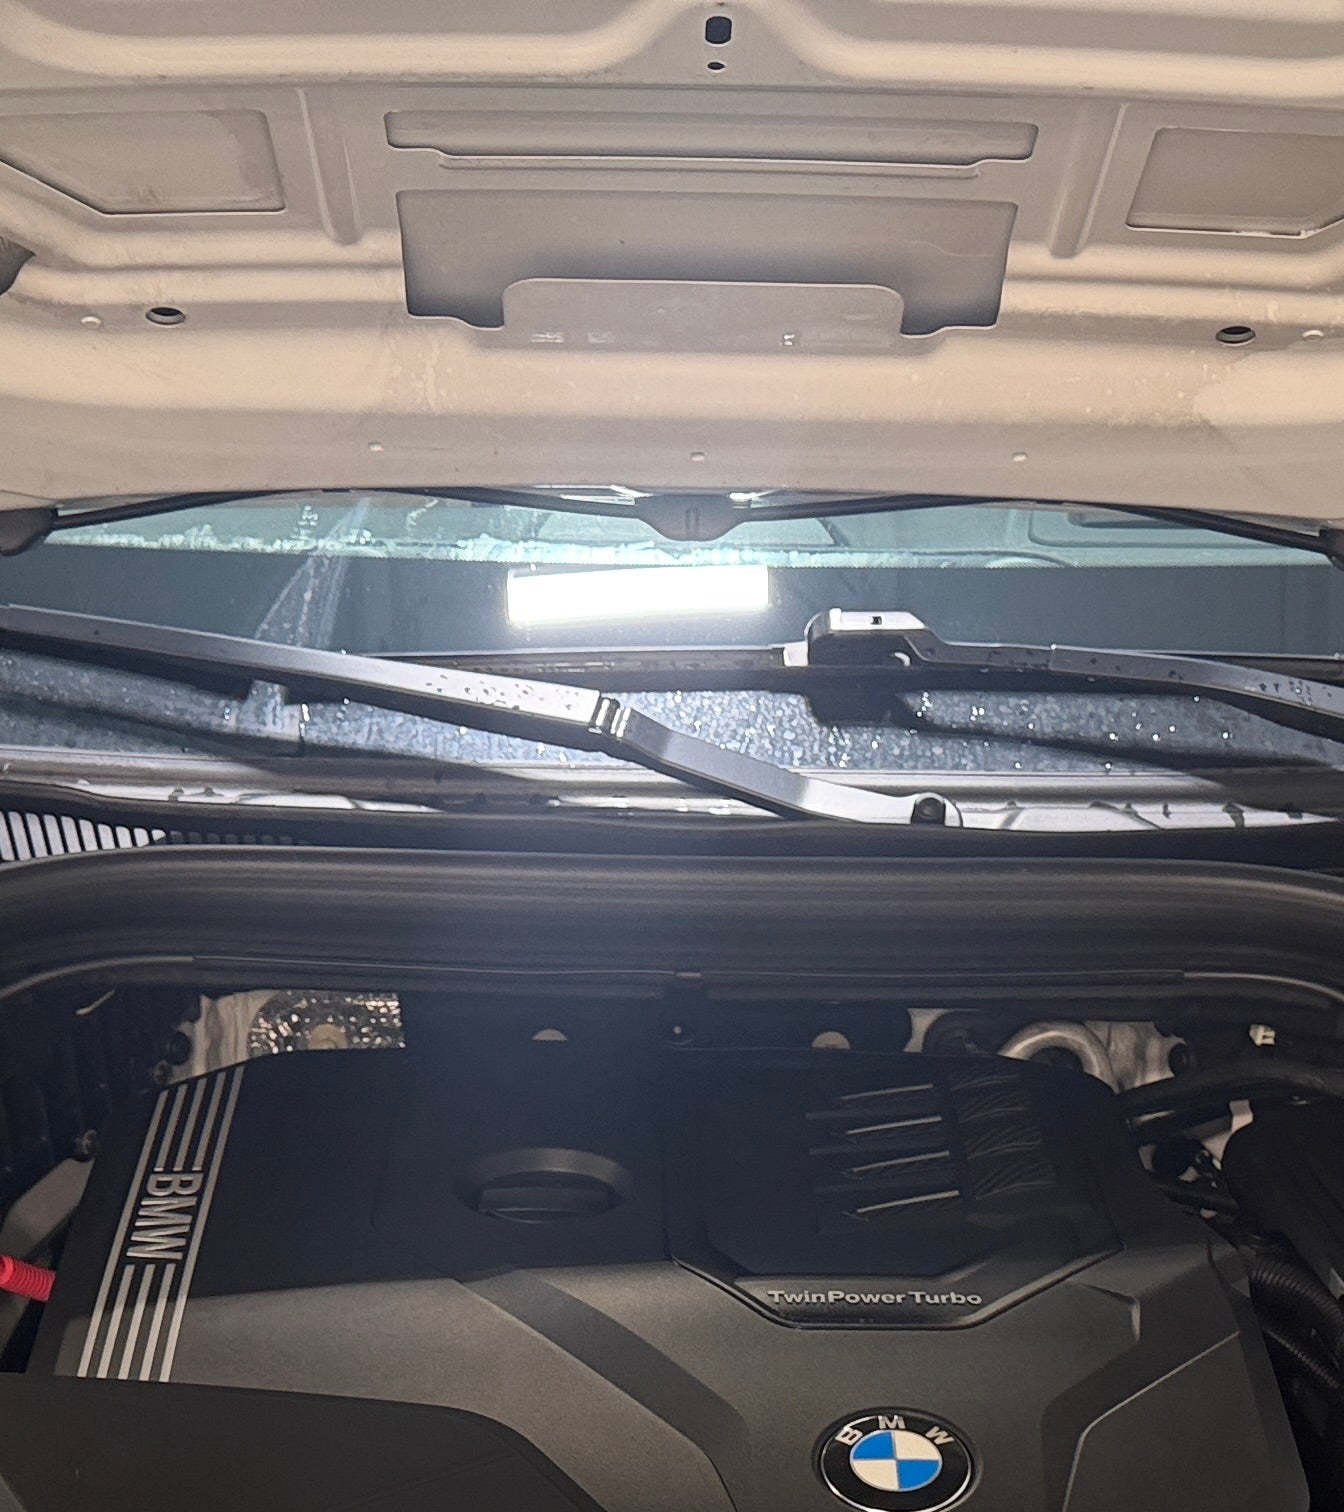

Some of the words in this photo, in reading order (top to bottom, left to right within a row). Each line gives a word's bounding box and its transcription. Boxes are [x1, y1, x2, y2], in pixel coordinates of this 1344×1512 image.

[126, 1172, 204, 1260] BMW
[766, 1289, 906, 1305] TwinPower
[907, 1290, 983, 1306] Turbo
[834, 1414, 955, 1446] BMW
